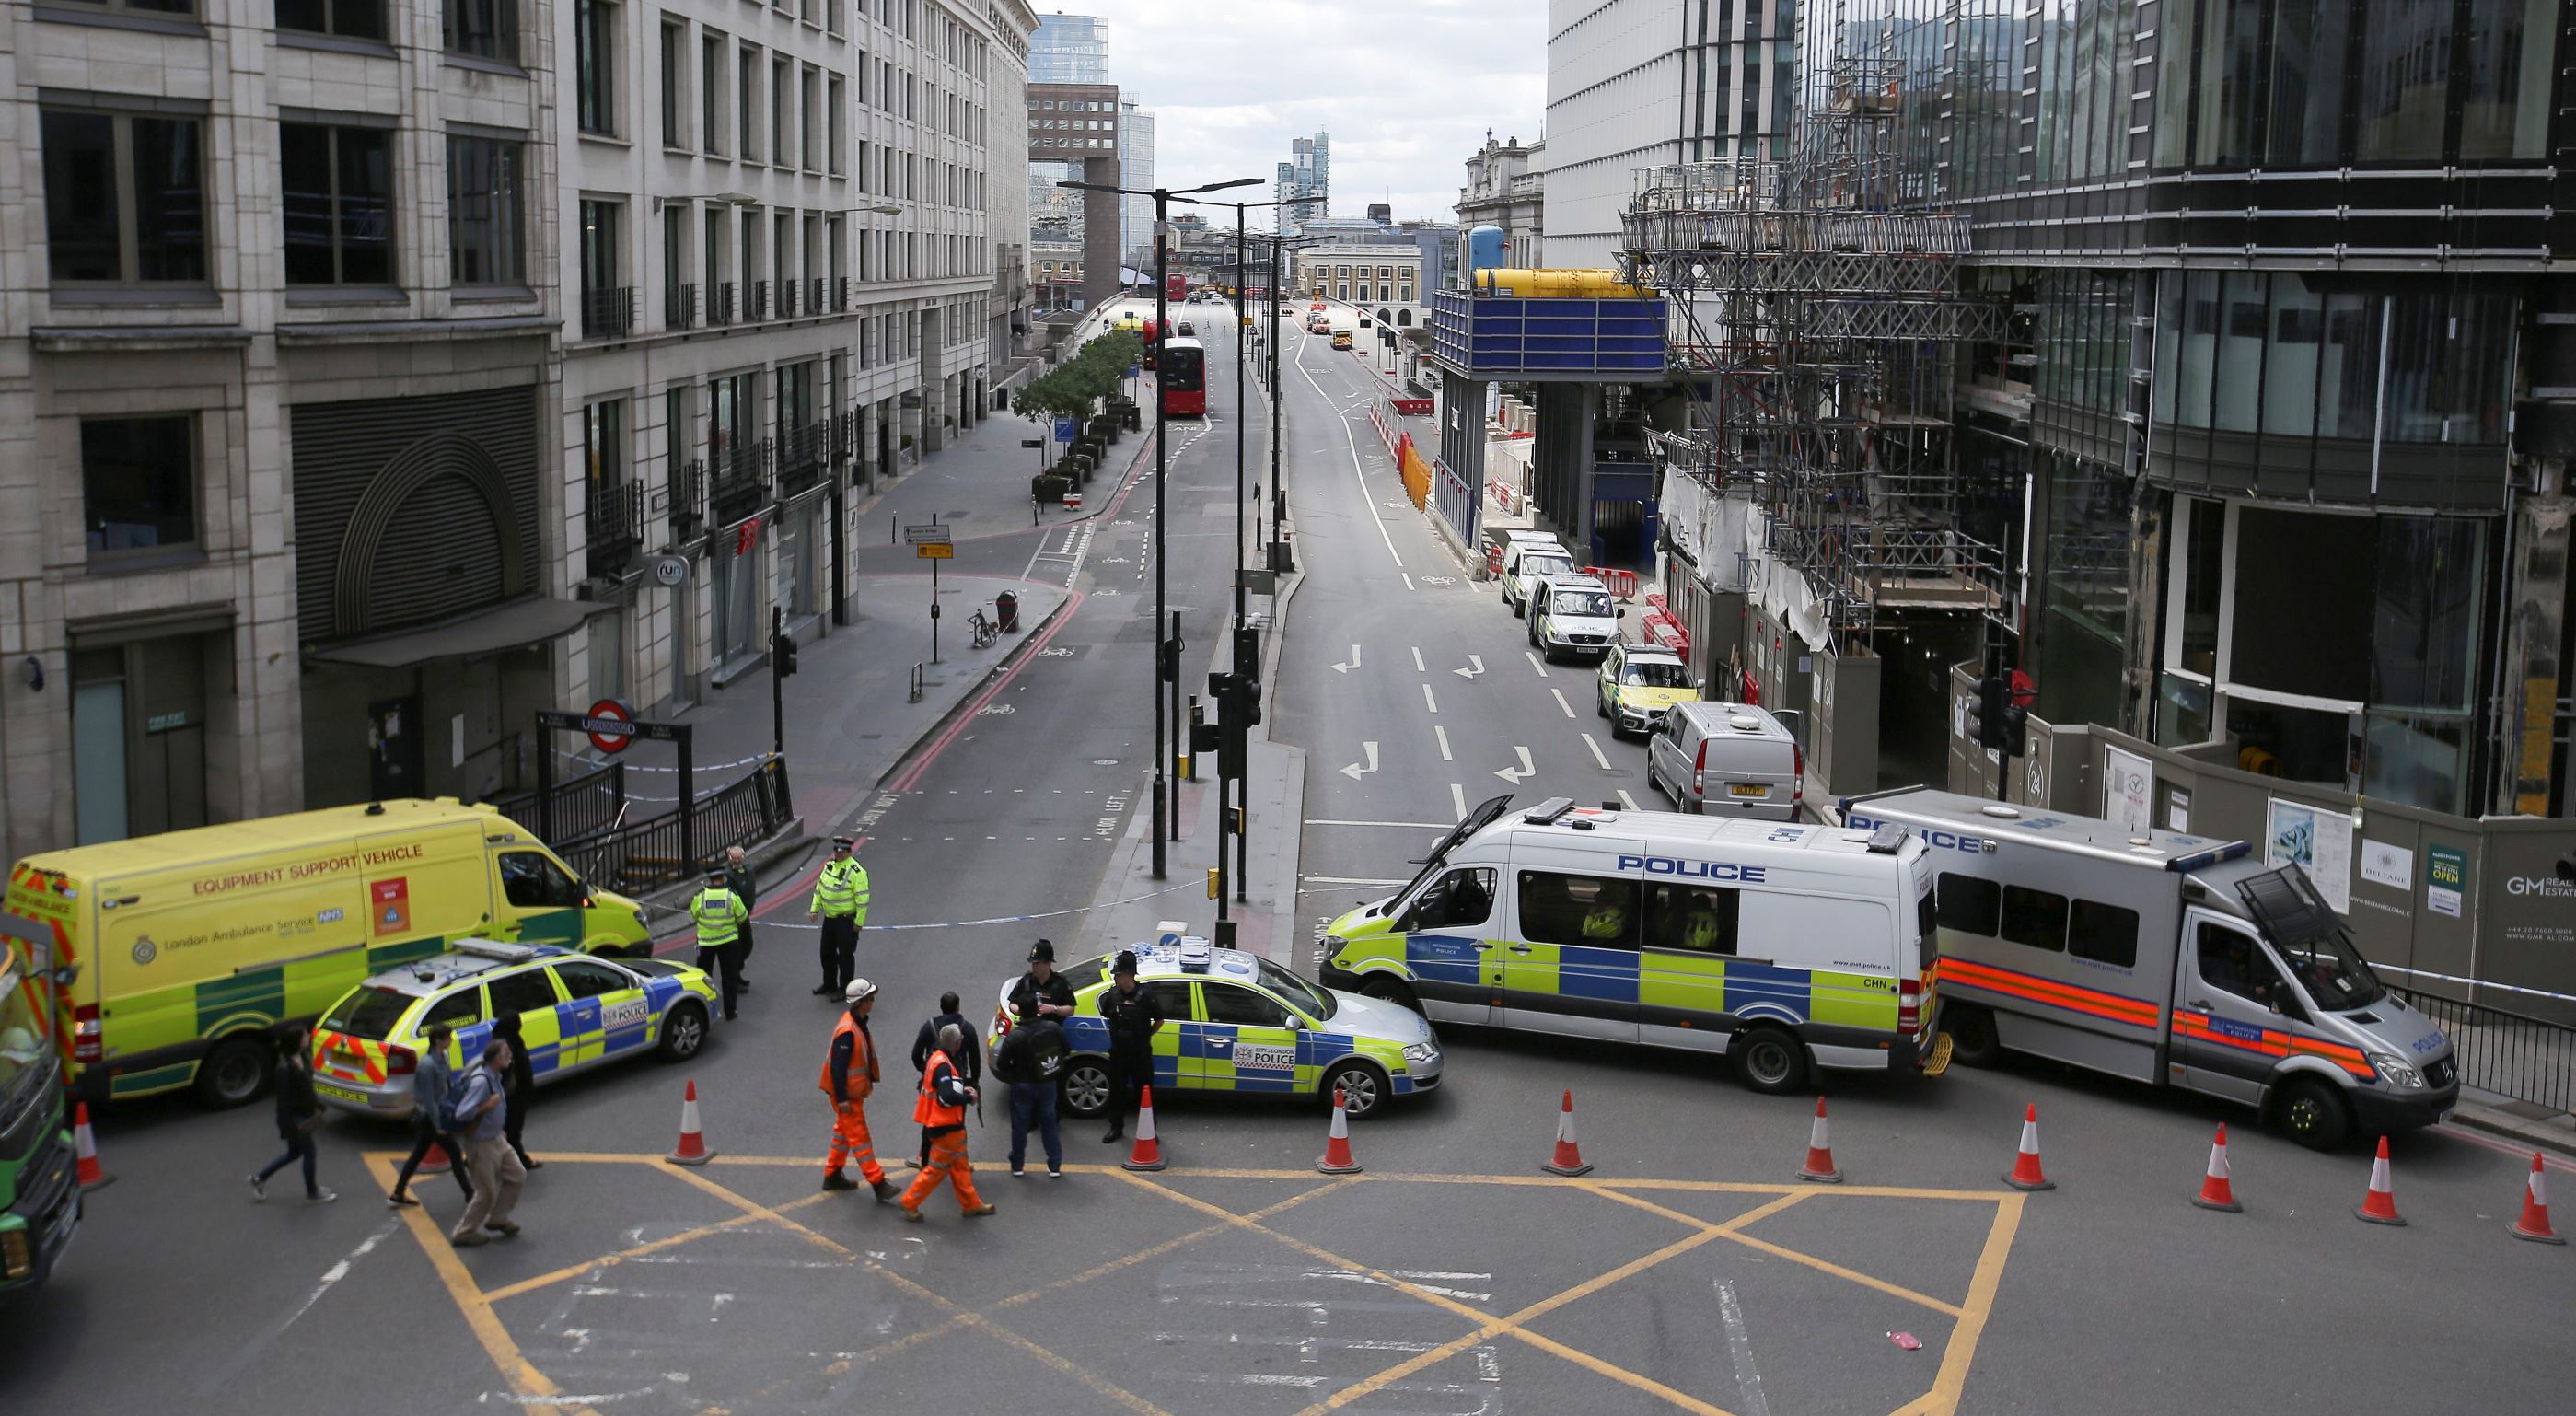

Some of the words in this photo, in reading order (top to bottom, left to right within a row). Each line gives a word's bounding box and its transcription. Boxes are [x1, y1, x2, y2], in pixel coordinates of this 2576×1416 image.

[659, 563, 681, 575] run
[1849, 815, 1981, 854] PICE
[193, 867, 284, 896] EQUIPMENT
[289, 854, 359, 878] SUPPORT
[362, 844, 424, 865] VEHICLE
[1617, 855, 1766, 883] POLICE
[2365, 868, 2407, 884] BELTANE
[2432, 869, 2459, 884] OPEN
[2506, 876, 2545, 896] GM
[2546, 877, 2572, 887] REAL
[164, 935, 208, 951] London
[213, 923, 273, 943] Ambulance
[277, 917, 315, 932] Service
[319, 909, 343, 923] NHS
[1863, 978, 1887, 989] CHN
[618, 1004, 647, 1021] POLICE
[1254, 1053, 1295, 1065] POLICE
